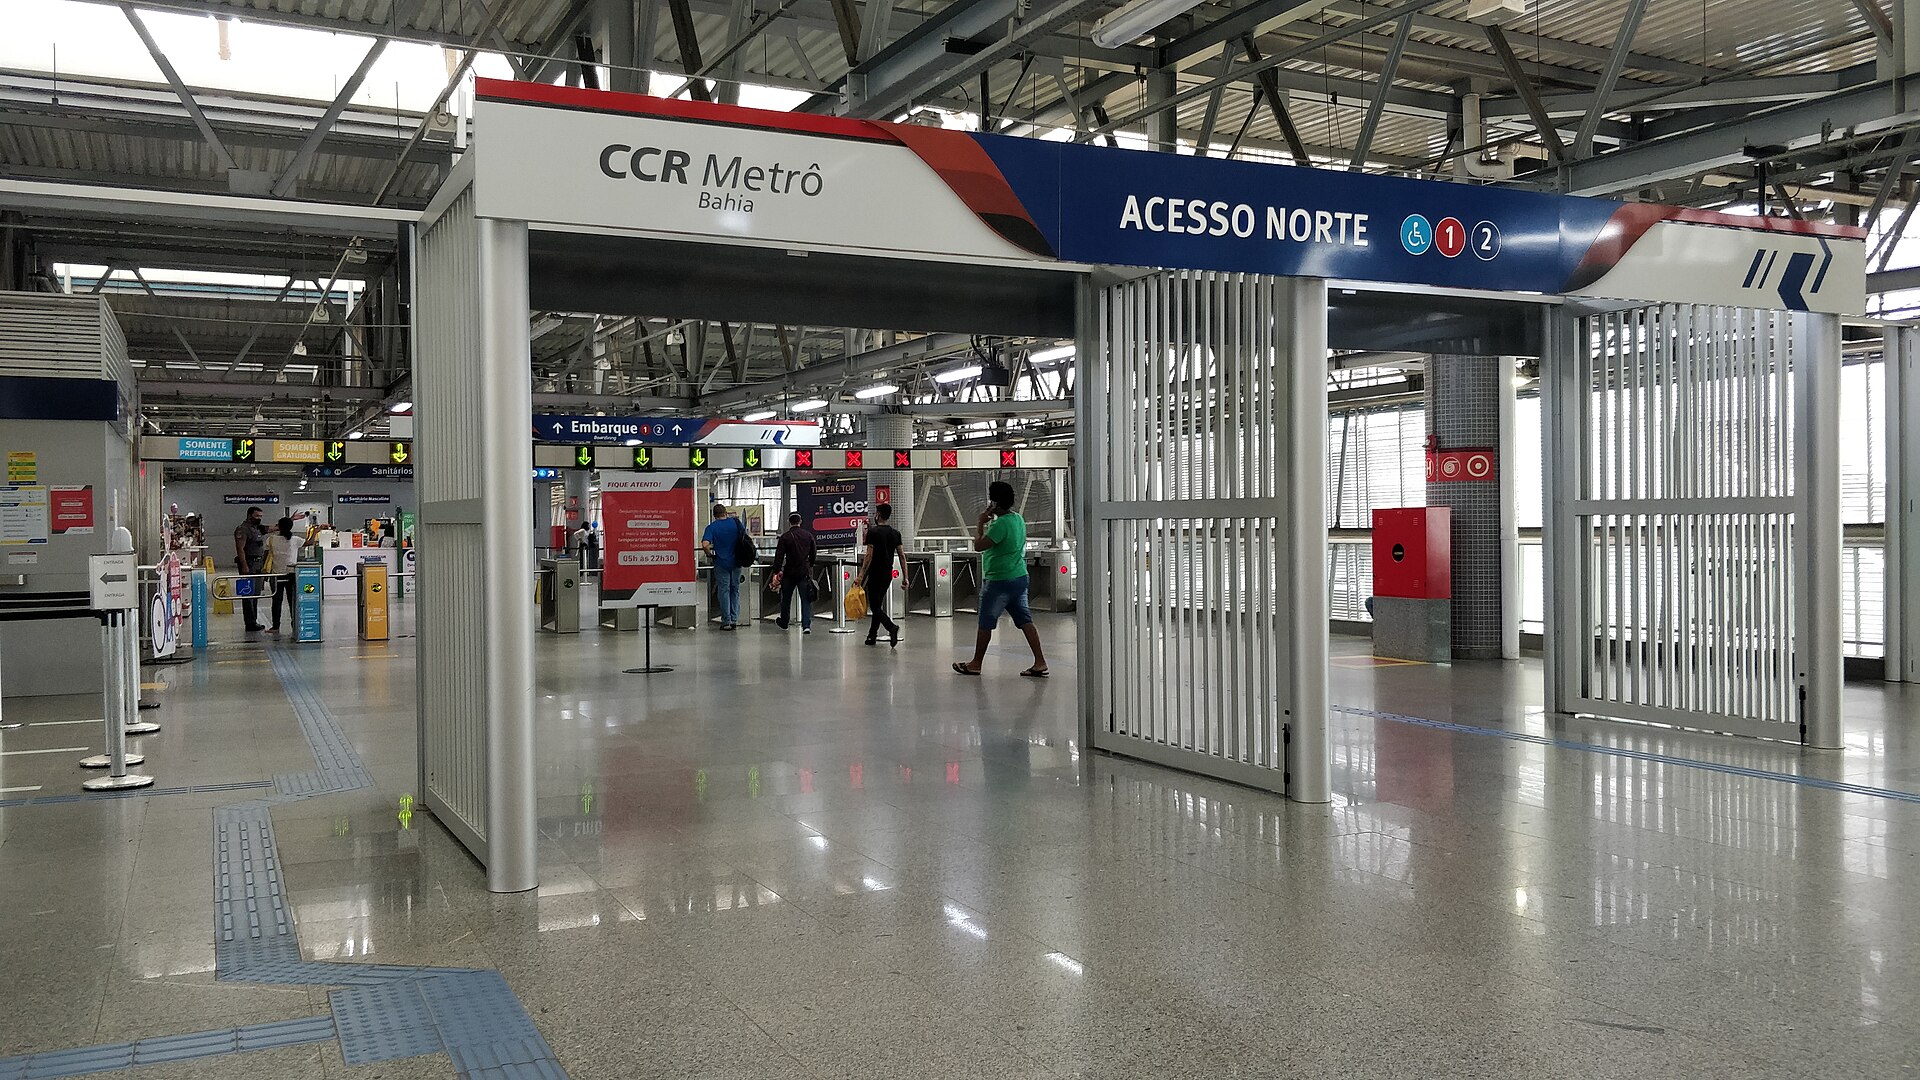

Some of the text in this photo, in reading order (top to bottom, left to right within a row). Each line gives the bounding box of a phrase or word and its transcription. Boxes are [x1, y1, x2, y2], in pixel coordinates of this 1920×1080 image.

[599, 144, 823, 196] CCR Metrô
[698, 192, 754, 213] Bahia
[1119, 195, 1492, 251] ACESSO NORTE 1 2
[571, 420, 638, 437] Embarque
[185, 440, 227, 449] SOMENTE
[279, 443, 319, 452] SOMENTE
[180, 449, 232, 458] PREFERENCIAL
[276, 452, 321, 460] GRATUIDADE
[372, 467, 413, 475] Sanitários
[825, 484, 840, 493] PRÉ
[622, 554, 638, 562] 05h
[650, 554, 675, 562] 22h30
